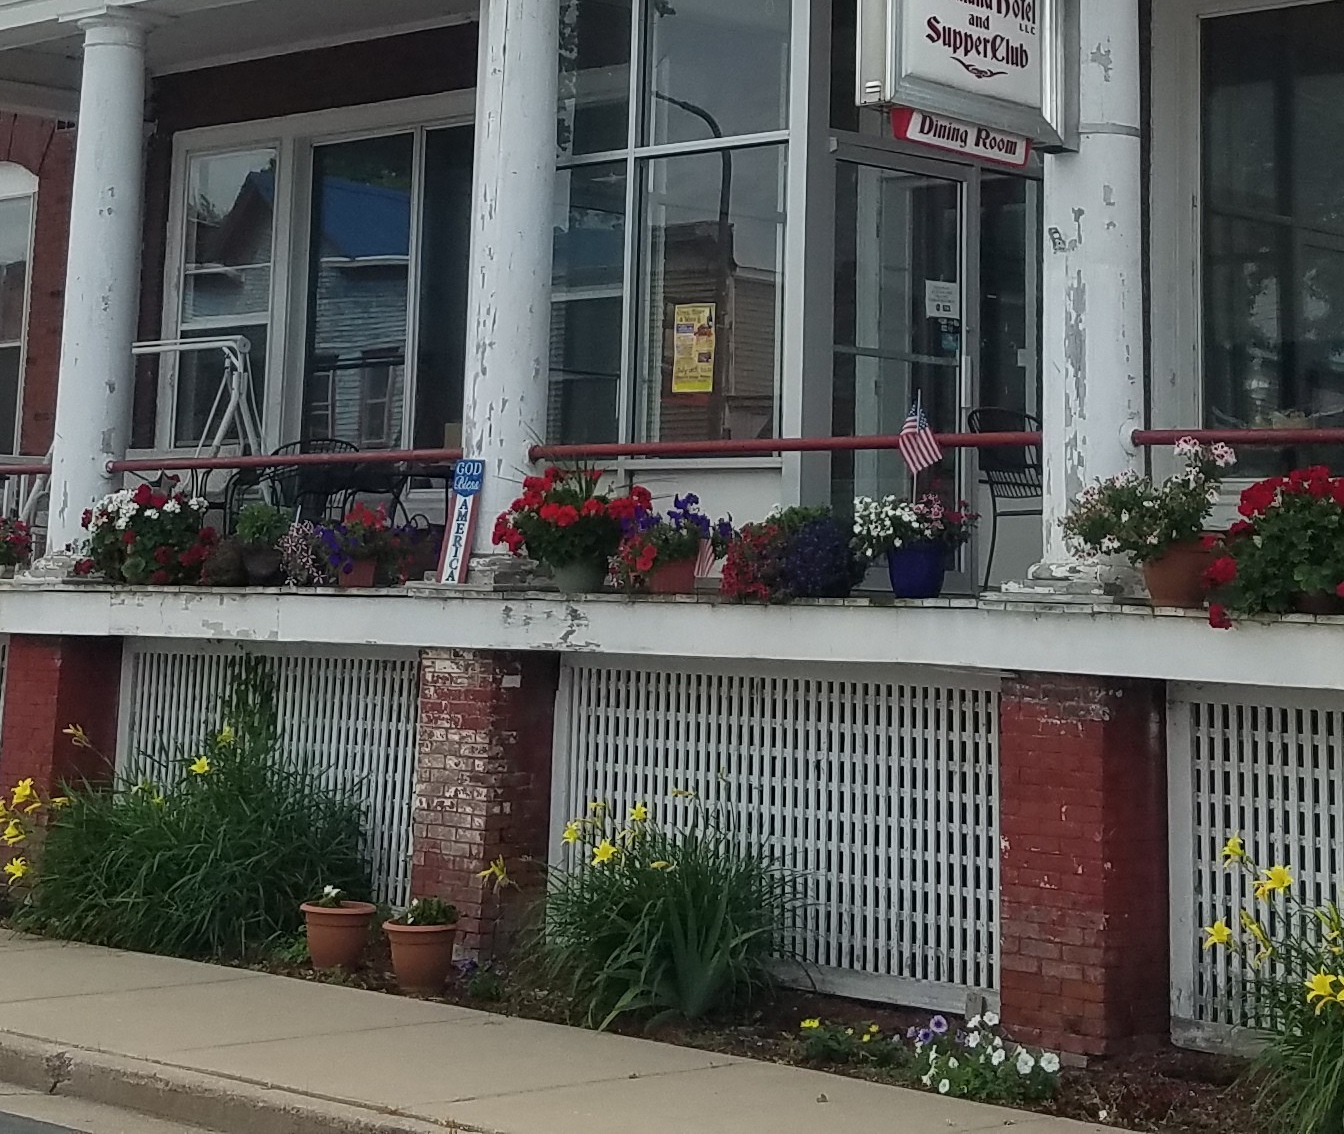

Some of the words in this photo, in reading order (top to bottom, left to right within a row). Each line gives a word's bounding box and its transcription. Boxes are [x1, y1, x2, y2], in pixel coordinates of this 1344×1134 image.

[968, 13, 990, 31] and
[1019, 22, 1036, 35] LLC
[918, 113, 969, 149] Dining
[974, 126, 1018, 156] Room
[456, 461, 482, 476] GOD
[454, 476, 482, 491] Bless
[444, 498, 469, 582] AMERICA
